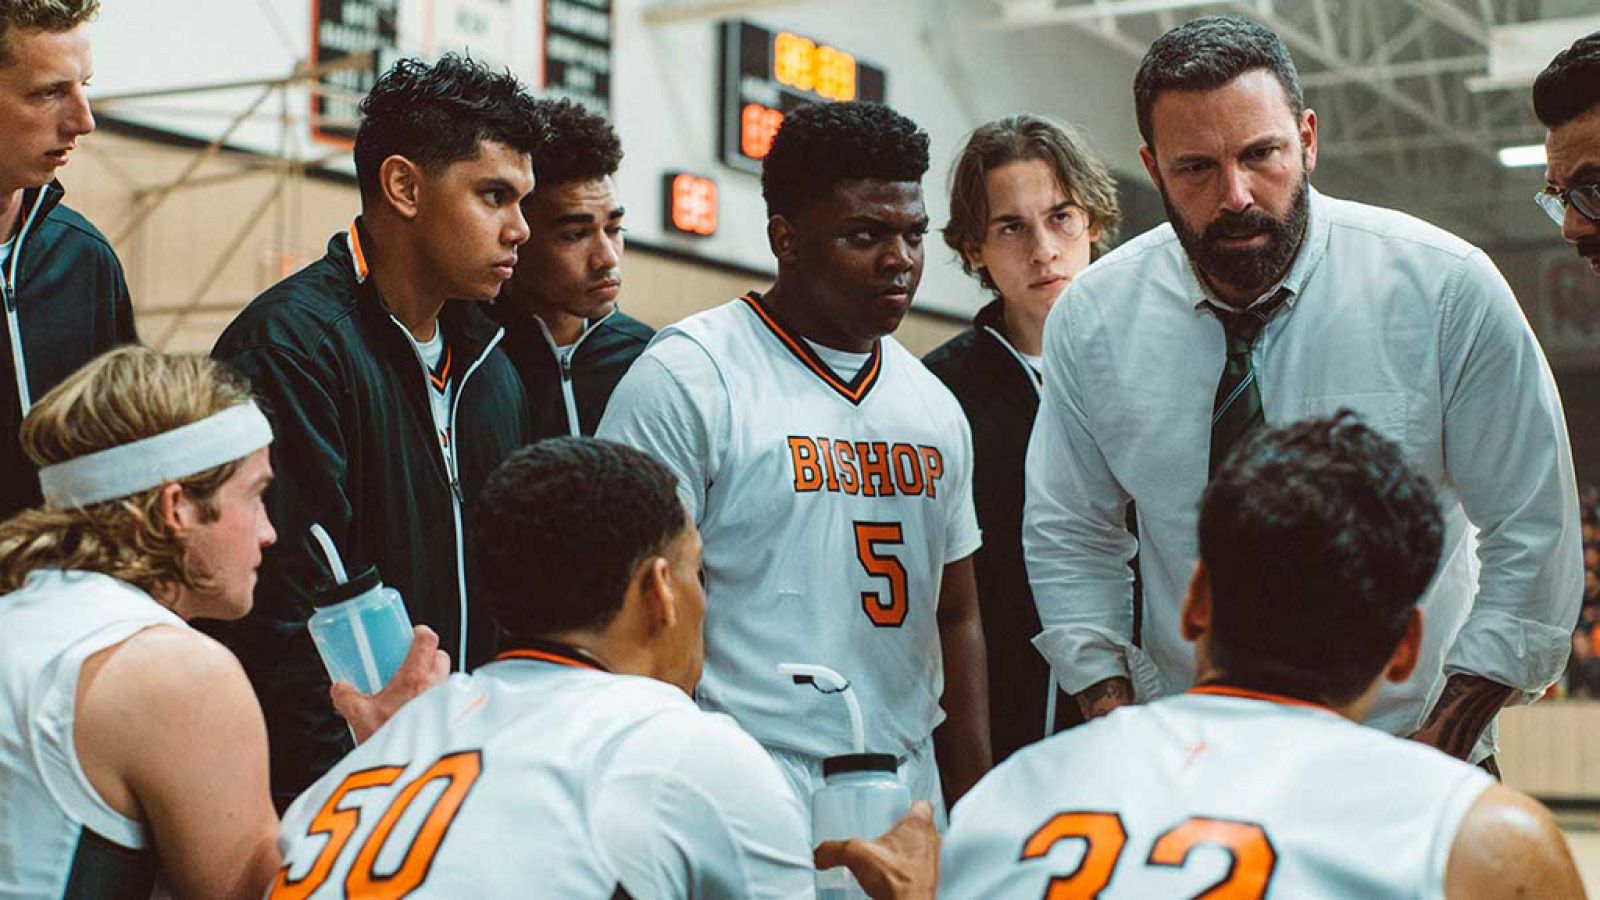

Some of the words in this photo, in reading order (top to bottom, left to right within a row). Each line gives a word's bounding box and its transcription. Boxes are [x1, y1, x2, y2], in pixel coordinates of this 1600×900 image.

[787, 436, 944, 499] BISHOP
[853, 520, 909, 628] 5
[268, 748, 483, 900] 50
